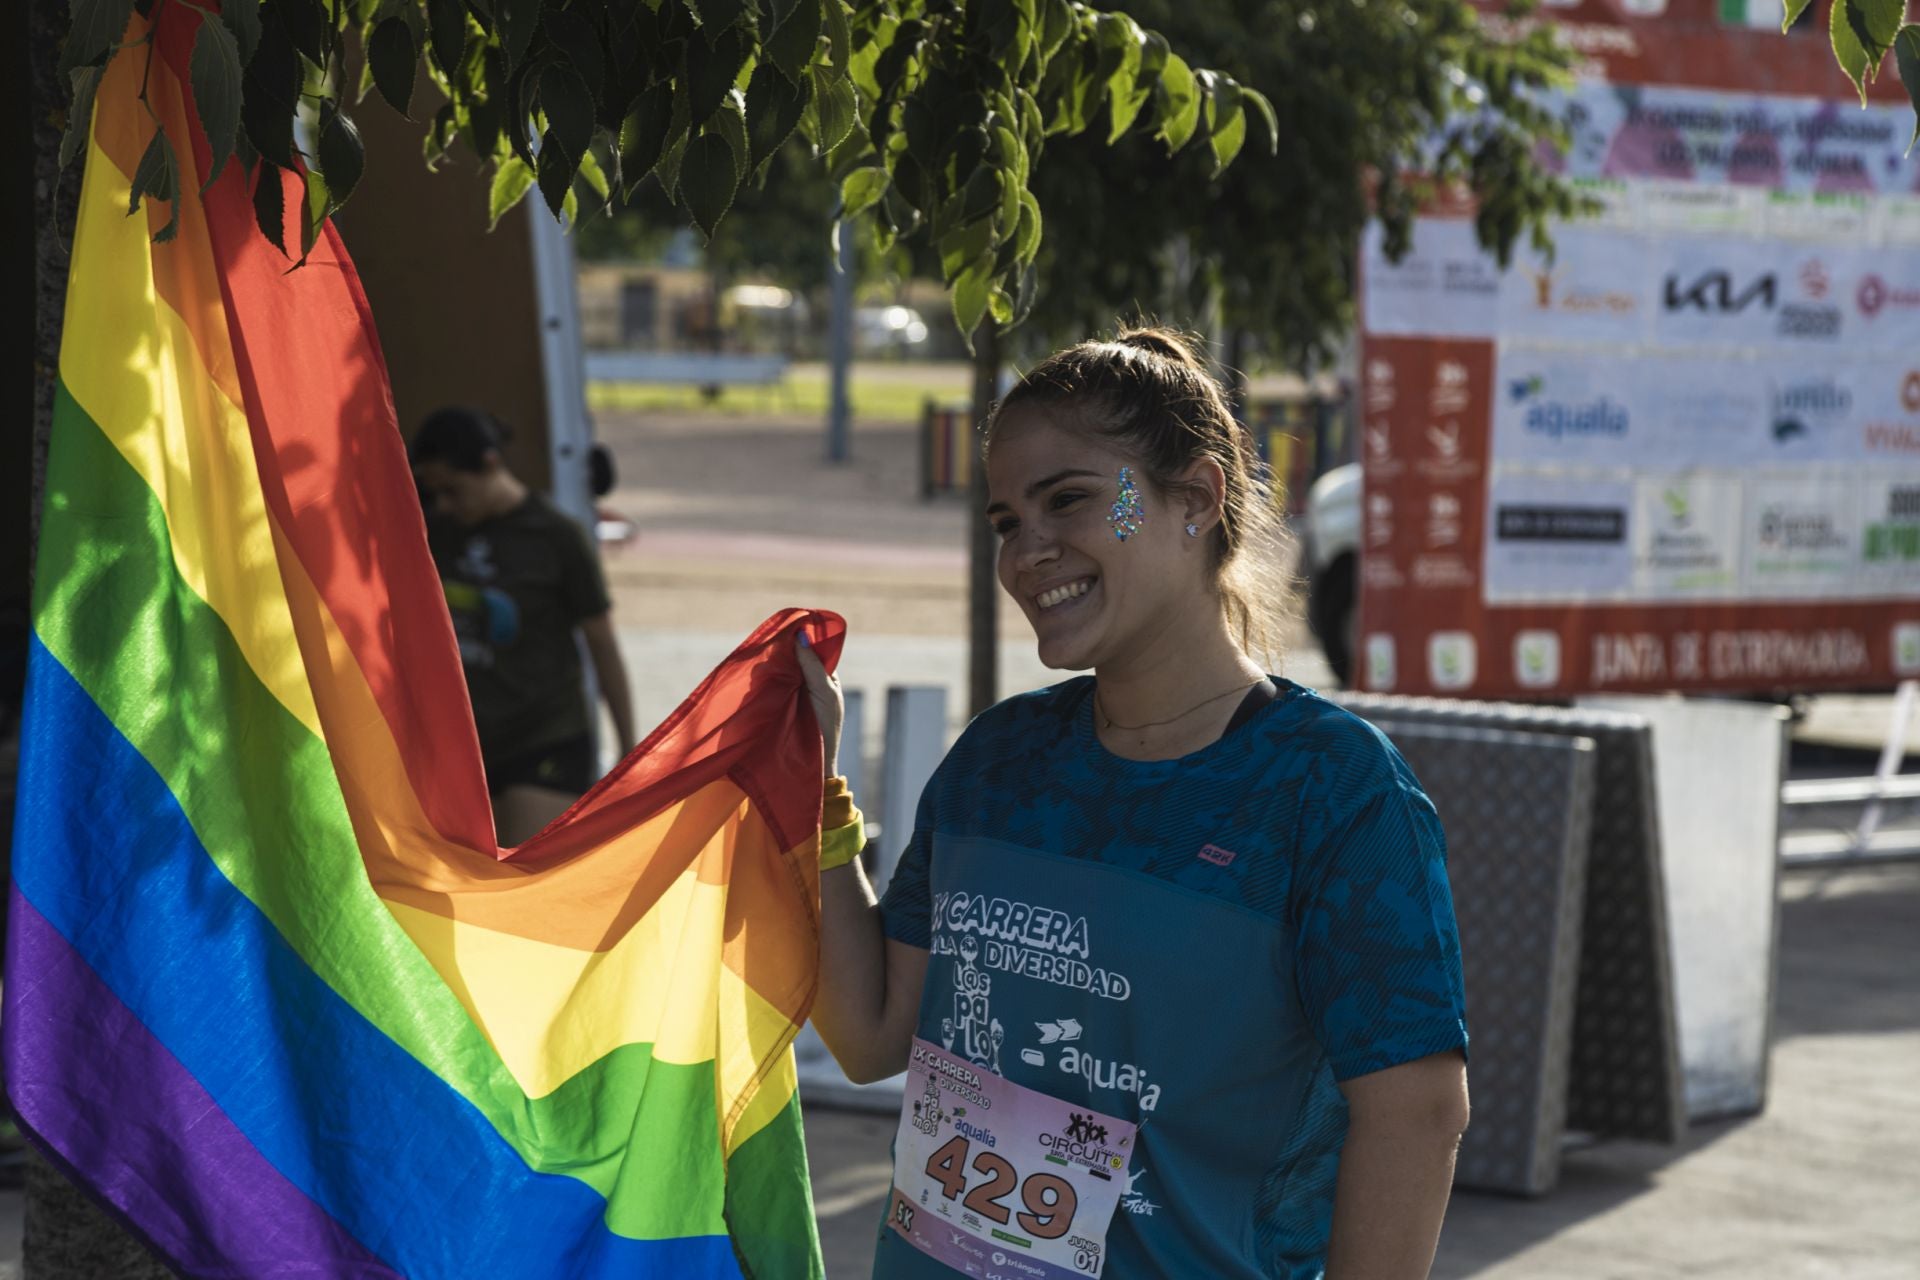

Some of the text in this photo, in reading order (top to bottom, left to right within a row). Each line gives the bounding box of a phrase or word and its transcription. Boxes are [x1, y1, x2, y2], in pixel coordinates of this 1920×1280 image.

[947, 891, 1090, 959] CARRERA
[984, 940, 1131, 1001] DIVERSIDAD
[953, 991, 989, 1029] pa
[964, 1017, 992, 1059] lo
[913, 1045, 927, 1064] IX
[927, 1052, 982, 1091] CARRERA
[1058, 1046, 1161, 1112] aquaia
[939, 1077, 992, 1111] DIVERSIDAD
[954, 1118, 997, 1148] aqualia
[1038, 1132, 1113, 1166] CIRCUIT
[925, 1134, 1078, 1240] 429
[1068, 1234, 1101, 1255] JUNIO
[1074, 1249, 1100, 1274] 01
